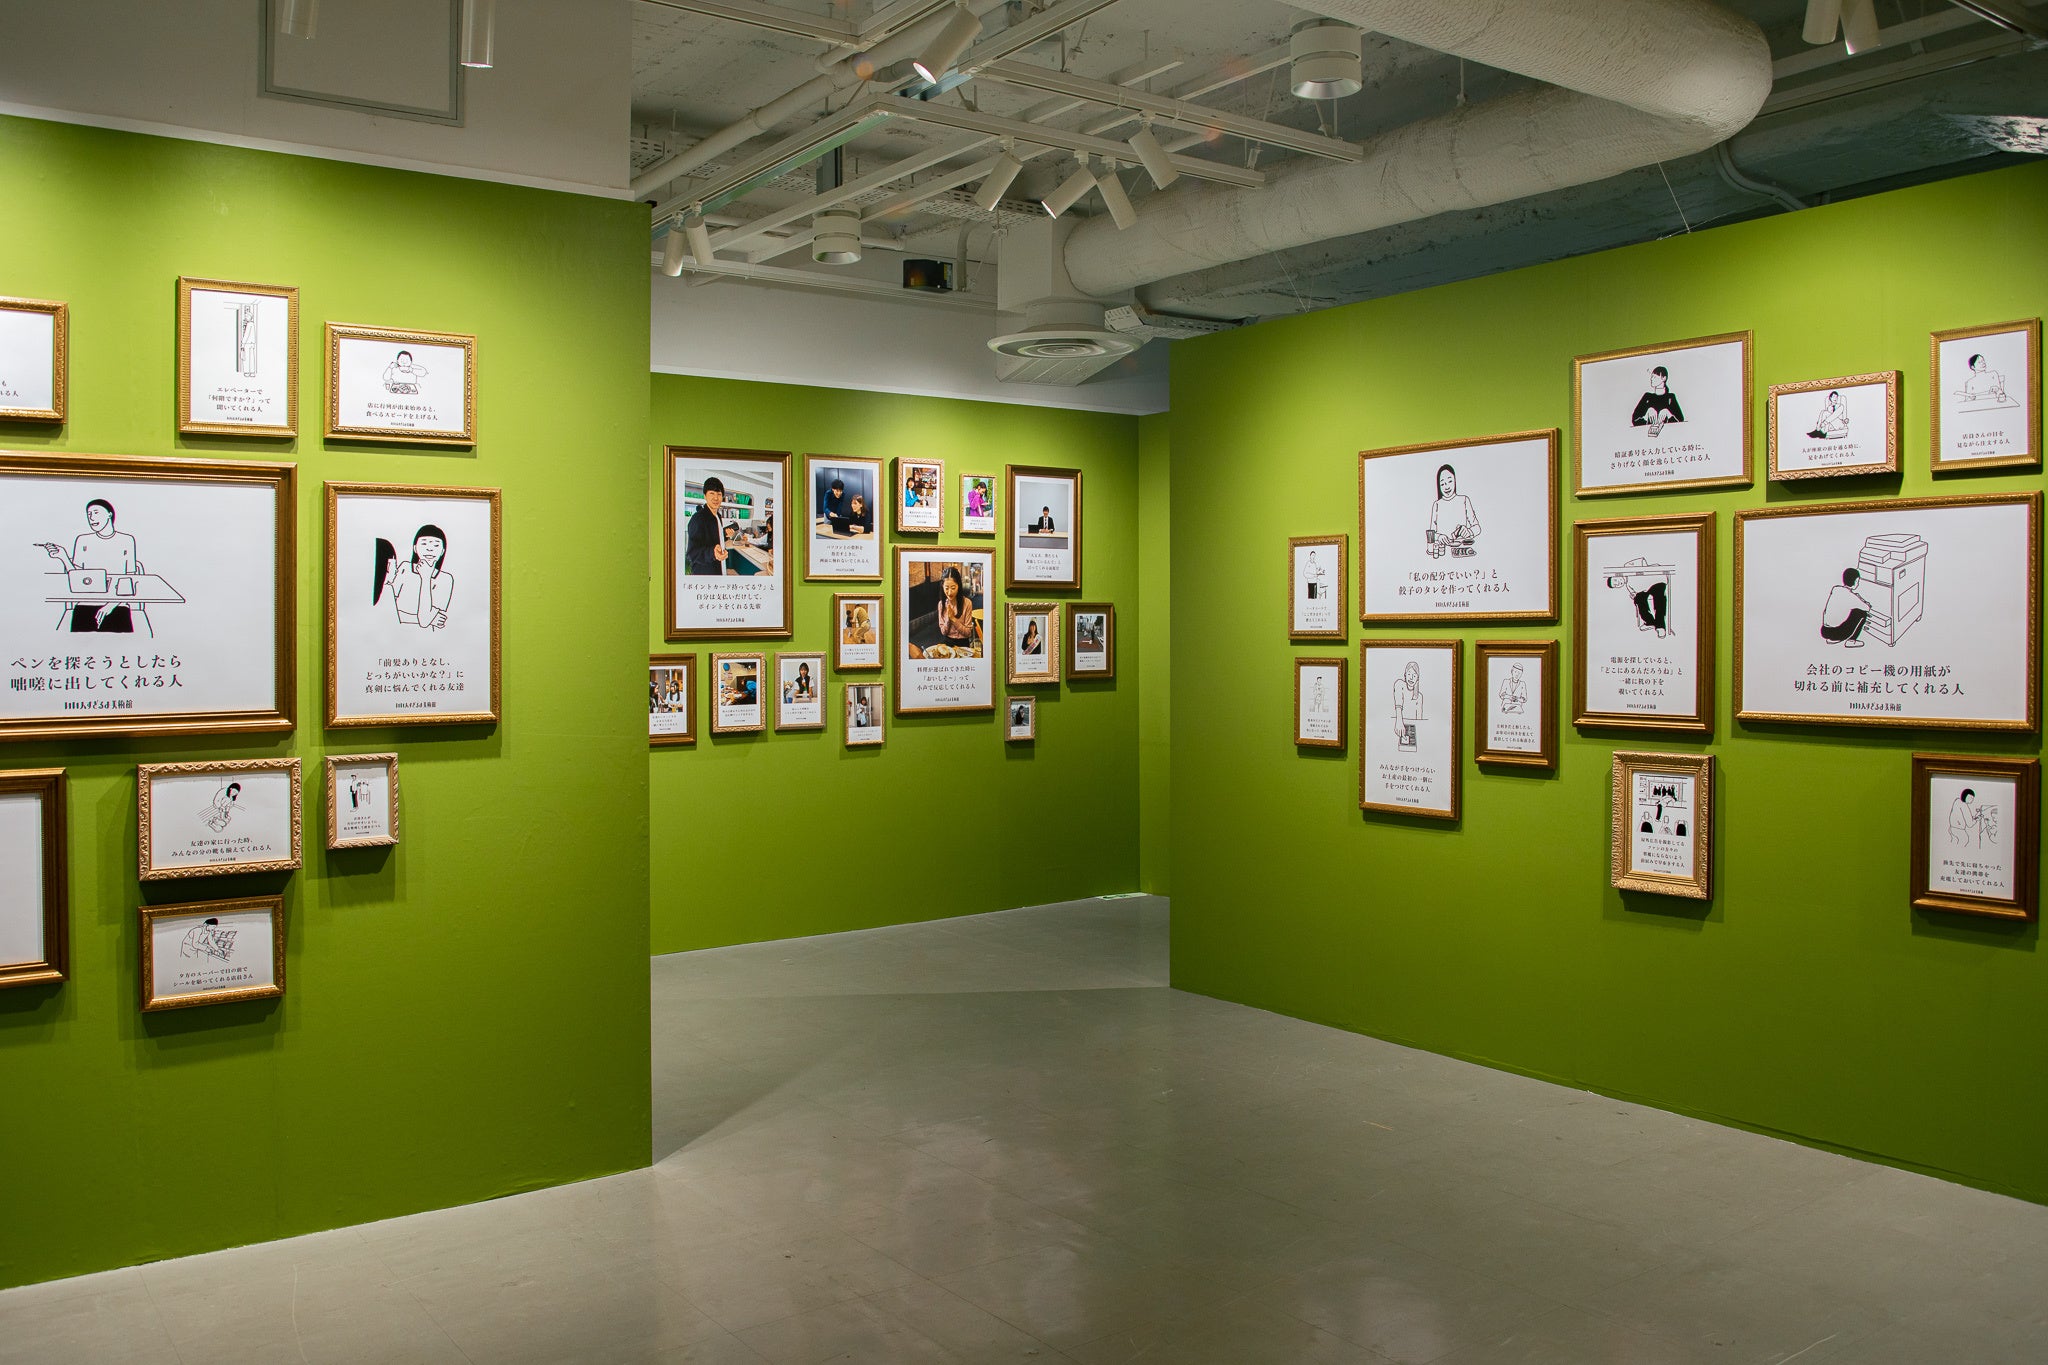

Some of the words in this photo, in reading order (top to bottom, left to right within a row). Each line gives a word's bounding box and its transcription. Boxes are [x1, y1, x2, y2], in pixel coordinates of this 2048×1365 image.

[1408, 568, 1498, 582] 「私の配分でいい？」と
[1398, 582, 1510, 596] 餃子のタレを作ってくれる人
[10, 654, 182, 670] ペンを探そうとしたら
[1806, 663, 1951, 678] 会社のコピー機の用紙が
[10, 674, 183, 692] 咄嗟に出してくれる人
[365, 682, 464, 694] 真剣に悩んでくれる友達
[1794, 680, 1965, 696] 切れる前に補充してくれる人
